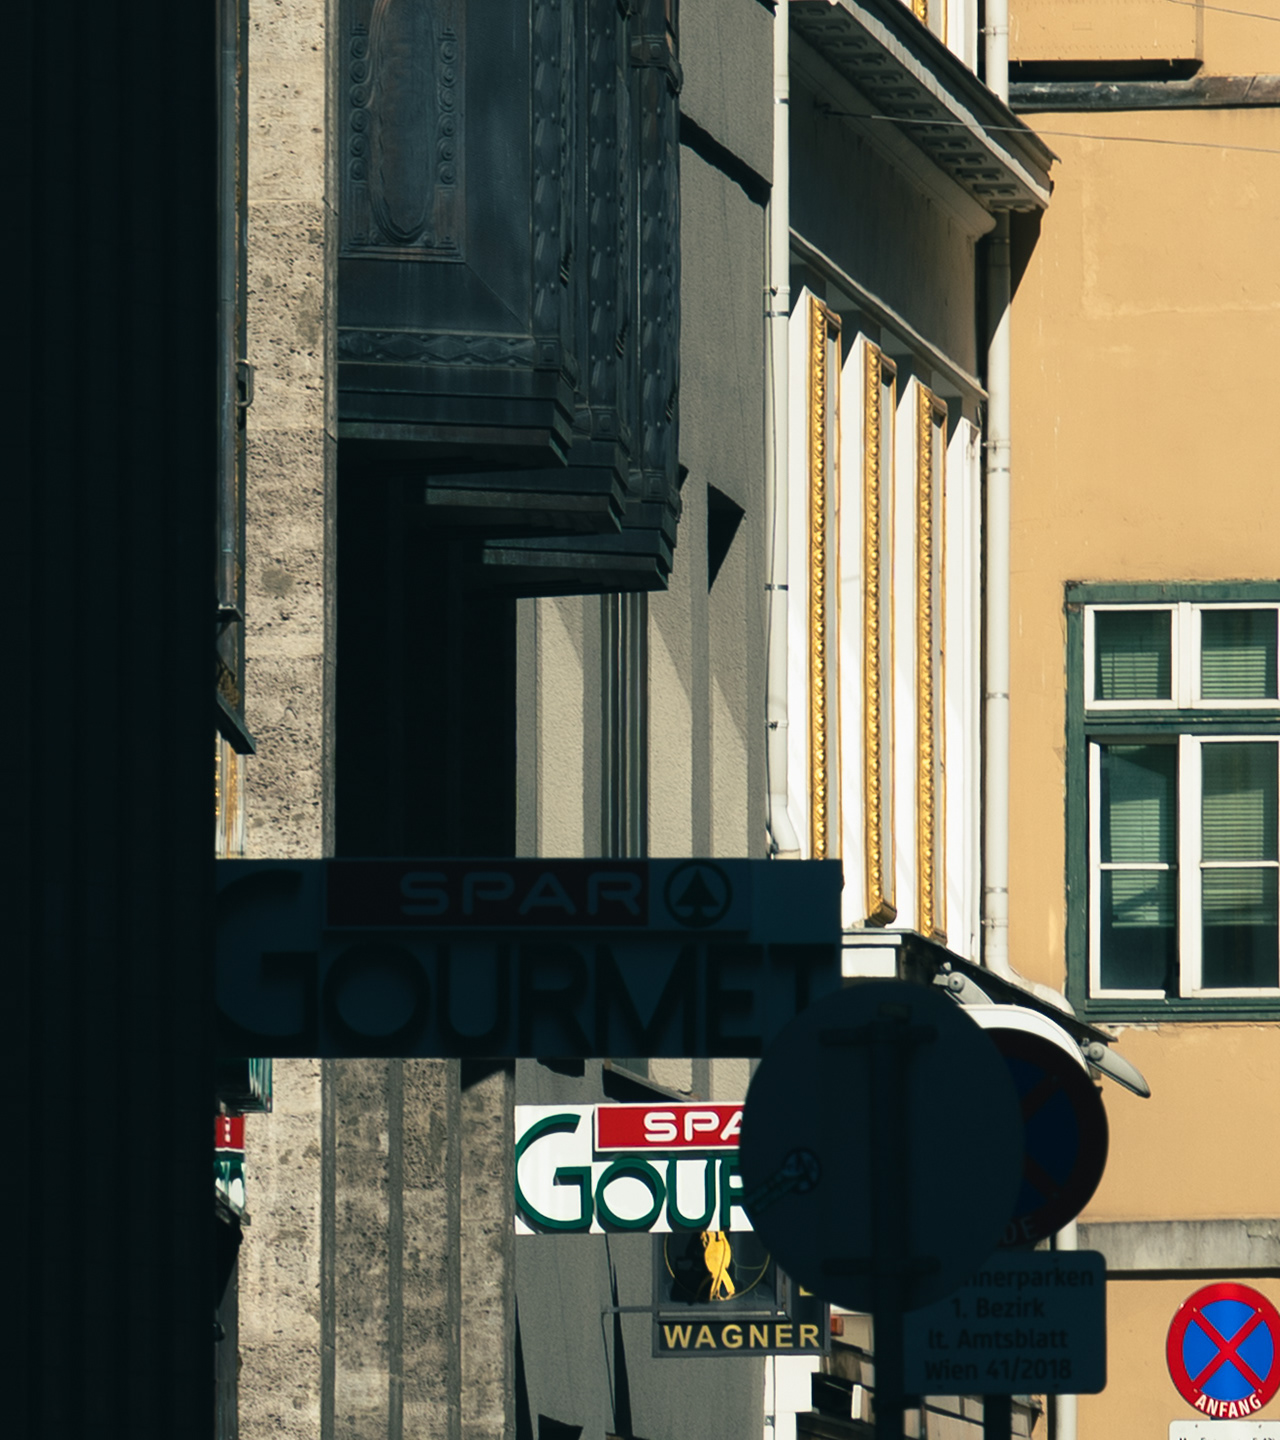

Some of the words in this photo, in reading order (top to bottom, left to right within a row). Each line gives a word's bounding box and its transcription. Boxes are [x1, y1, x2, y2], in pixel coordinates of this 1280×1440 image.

[400, 871, 642, 917] SPAR
[214, 868, 837, 1057] GOURMET
[644, 1111, 742, 1142] SPA
[515, 1113, 753, 1232] GOUR
[951, 1297, 967, 1319] 1.
[976, 1296, 1045, 1319] Bezirk
[663, 1324, 820, 1349] WAGNER
[957, 1328, 1068, 1349] Amtsblatt
[925, 1359, 978, 1380] Wien
[986, 1357, 1072, 1382] 41/2018
[1194, 1394, 1262, 1418] ANFANG
